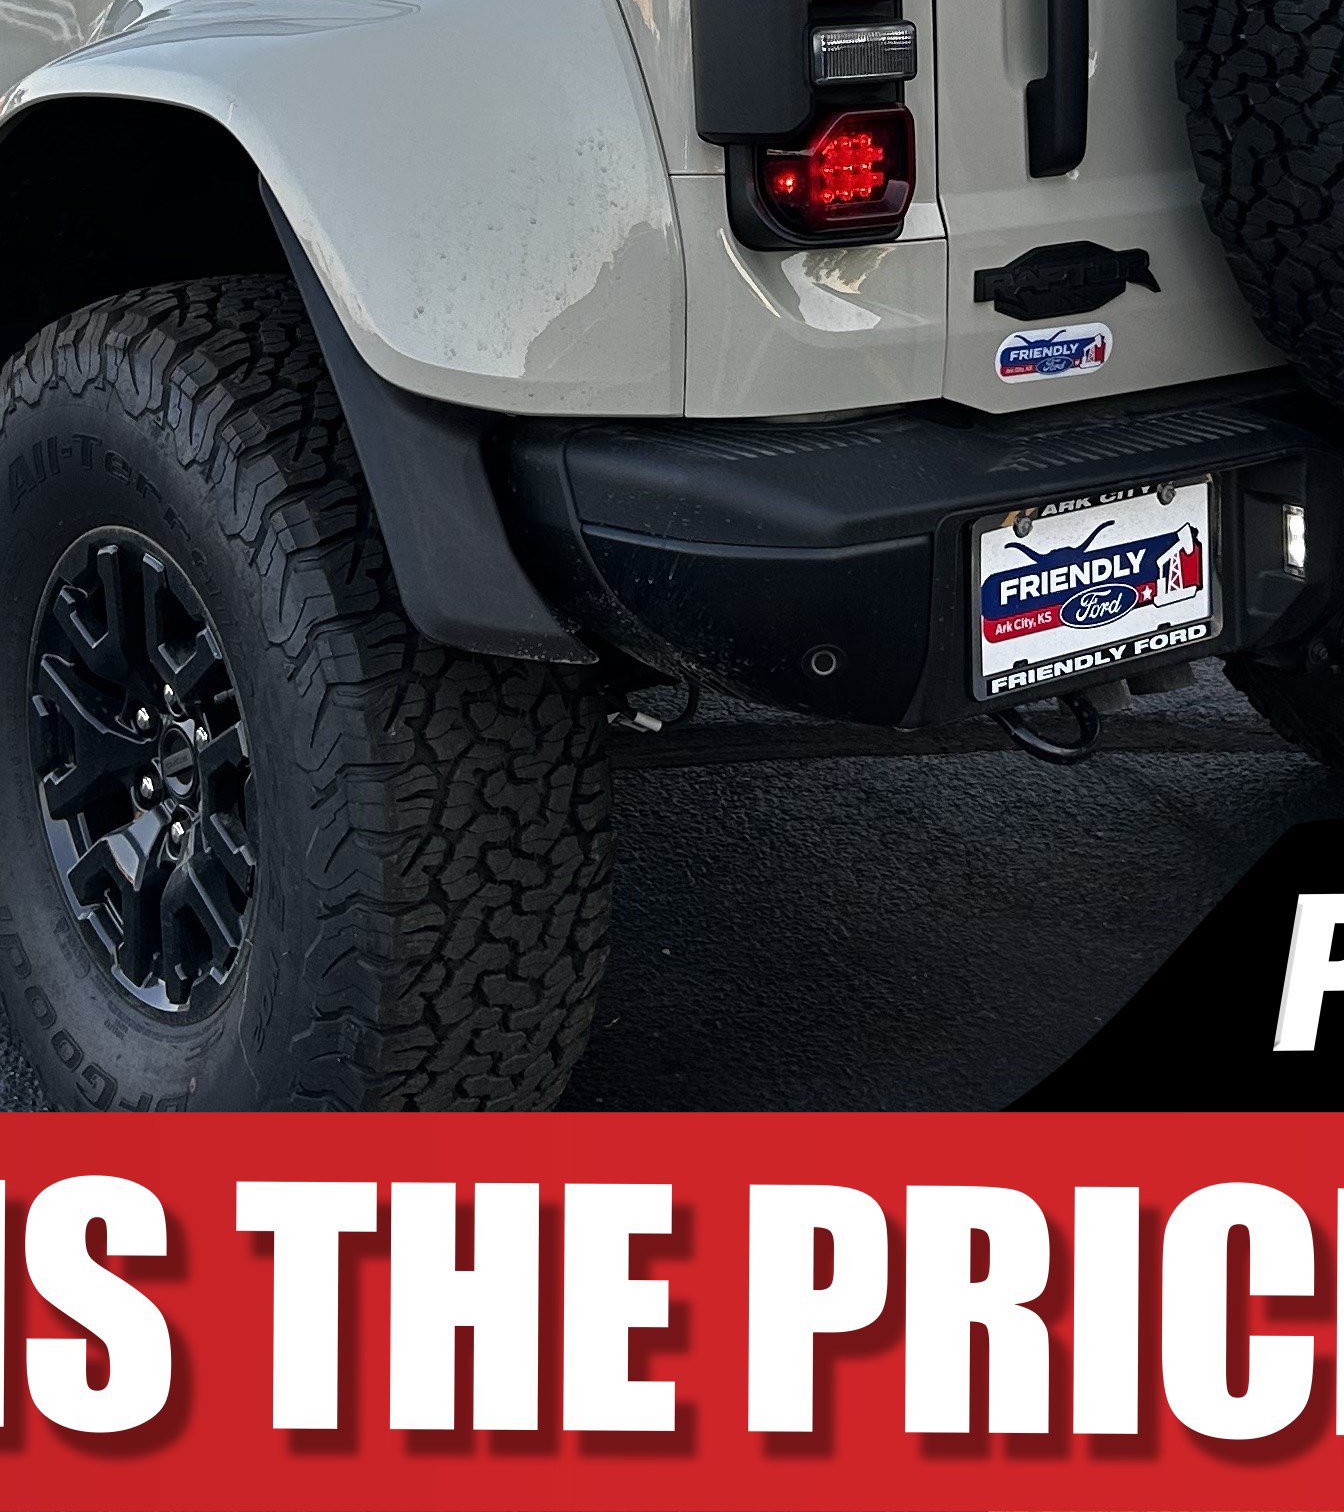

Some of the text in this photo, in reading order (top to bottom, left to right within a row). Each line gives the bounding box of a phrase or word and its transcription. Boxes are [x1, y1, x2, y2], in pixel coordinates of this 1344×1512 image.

[1009, 343, 1079, 361] FRIENDLY
[1040, 496, 1092, 517] ARK
[1000, 548, 1147, 606] FRIENDLY
[1075, 588, 1123, 622] Ford
[995, 611, 1052, 636] Ark City, KS
[991, 624, 1208, 694] FRIENDLY FORD
